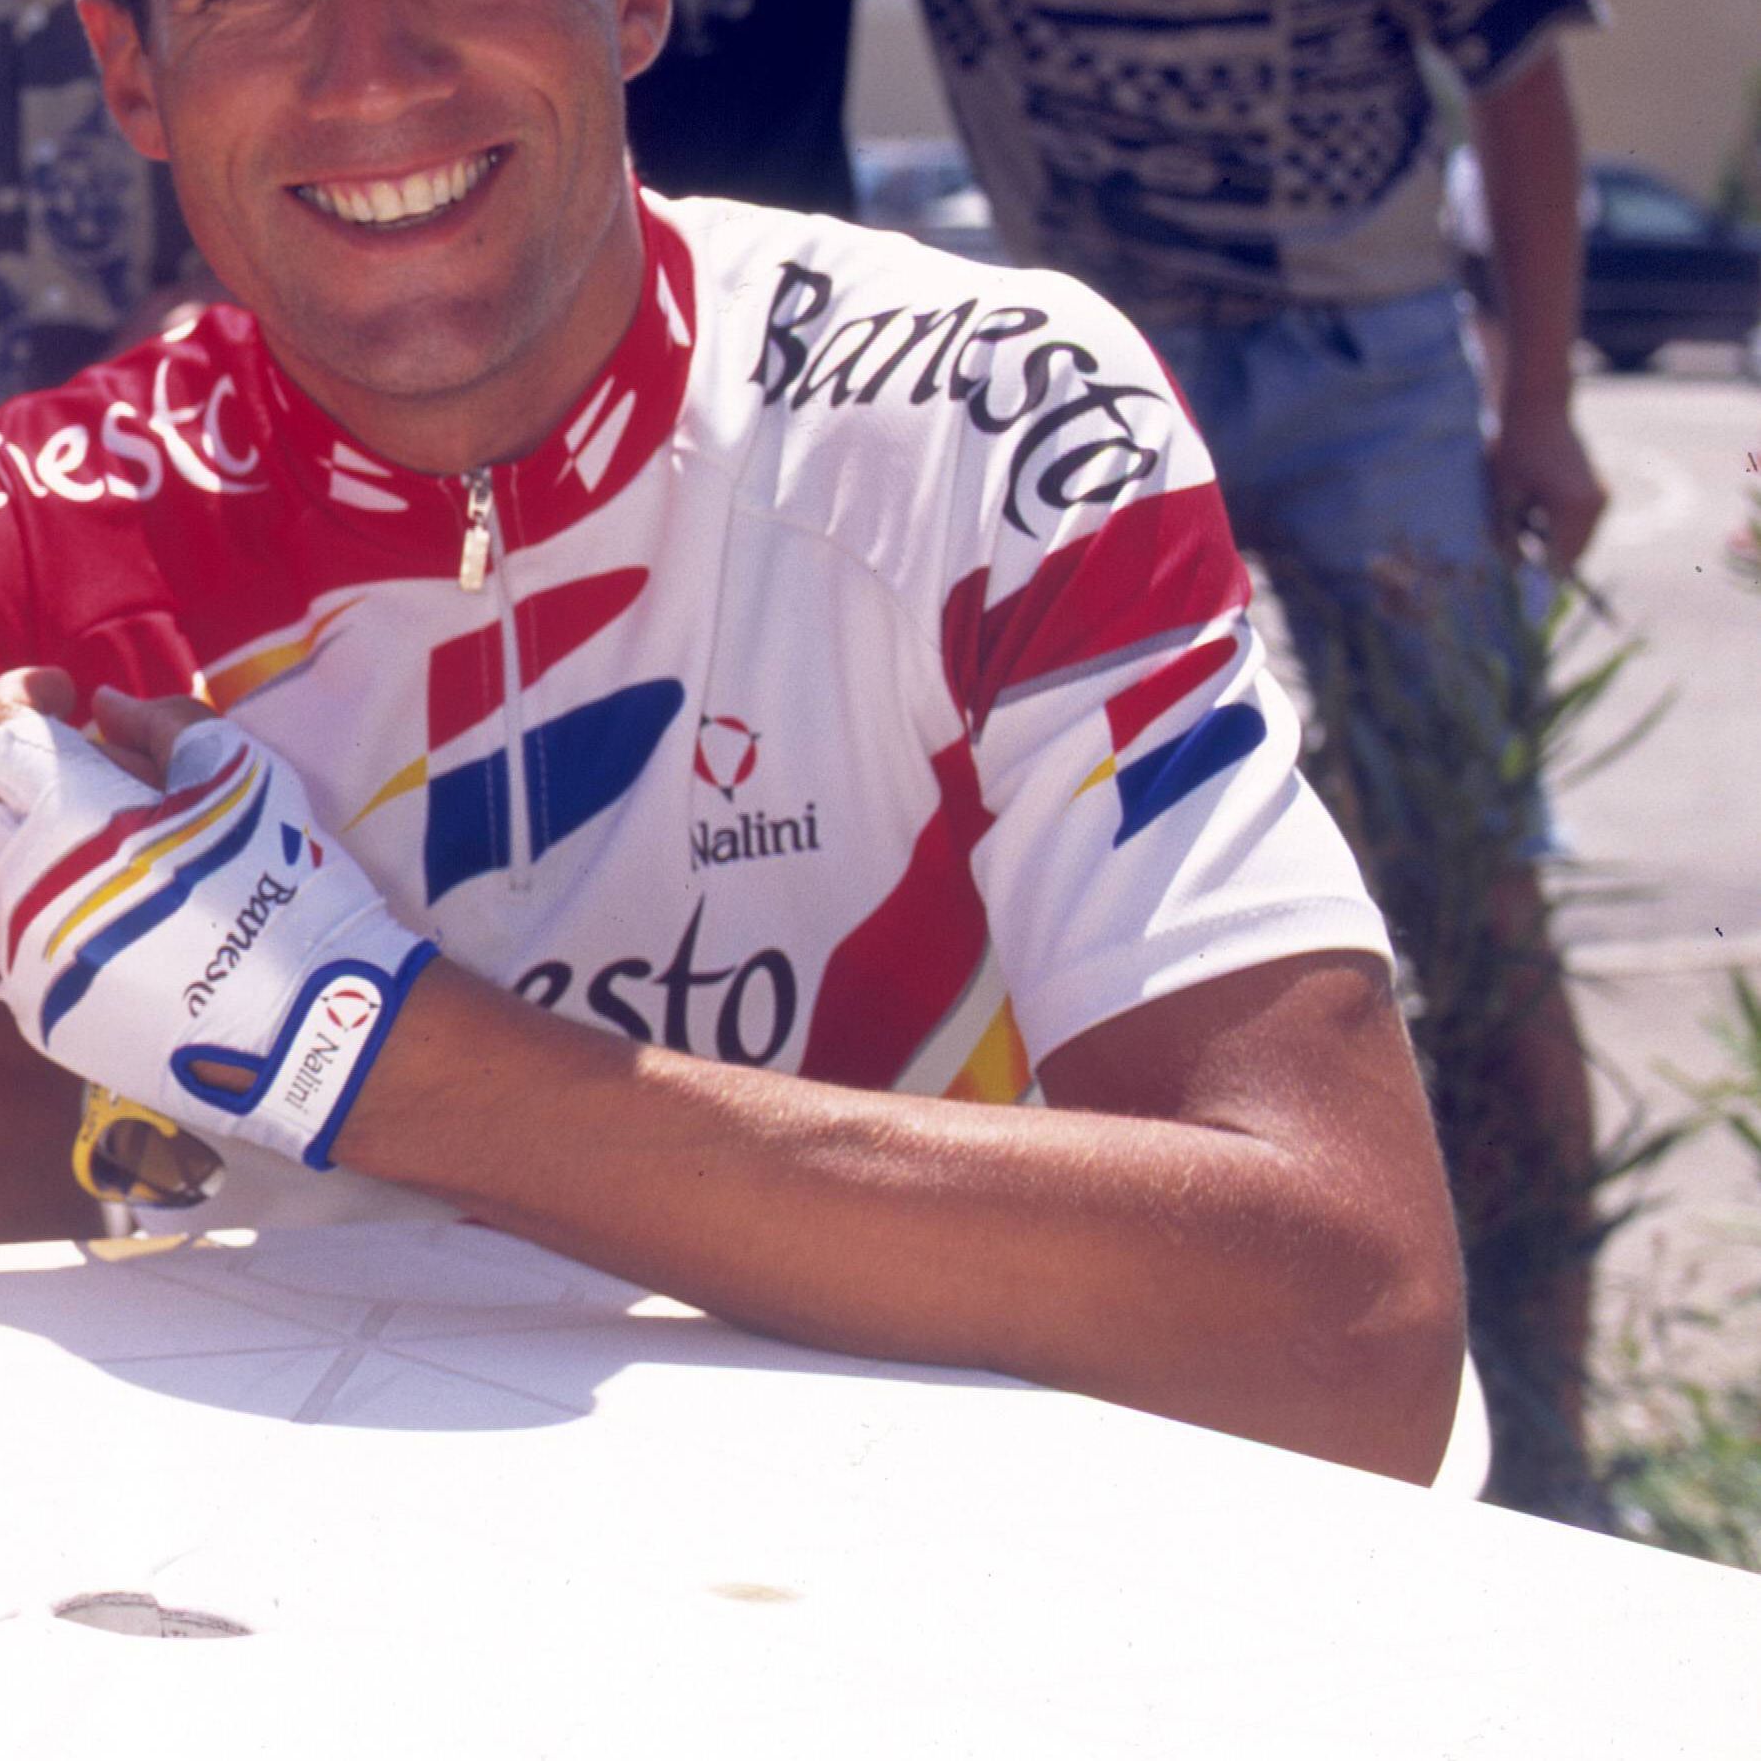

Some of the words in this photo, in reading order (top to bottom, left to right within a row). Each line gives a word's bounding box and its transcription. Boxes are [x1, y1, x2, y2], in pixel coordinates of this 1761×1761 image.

[749, 260, 1169, 541] Banesto
[688, 801, 821, 871] Nalini
[512, 892, 798, 1068] esto
[283, 1031, 340, 1118] Nalini
